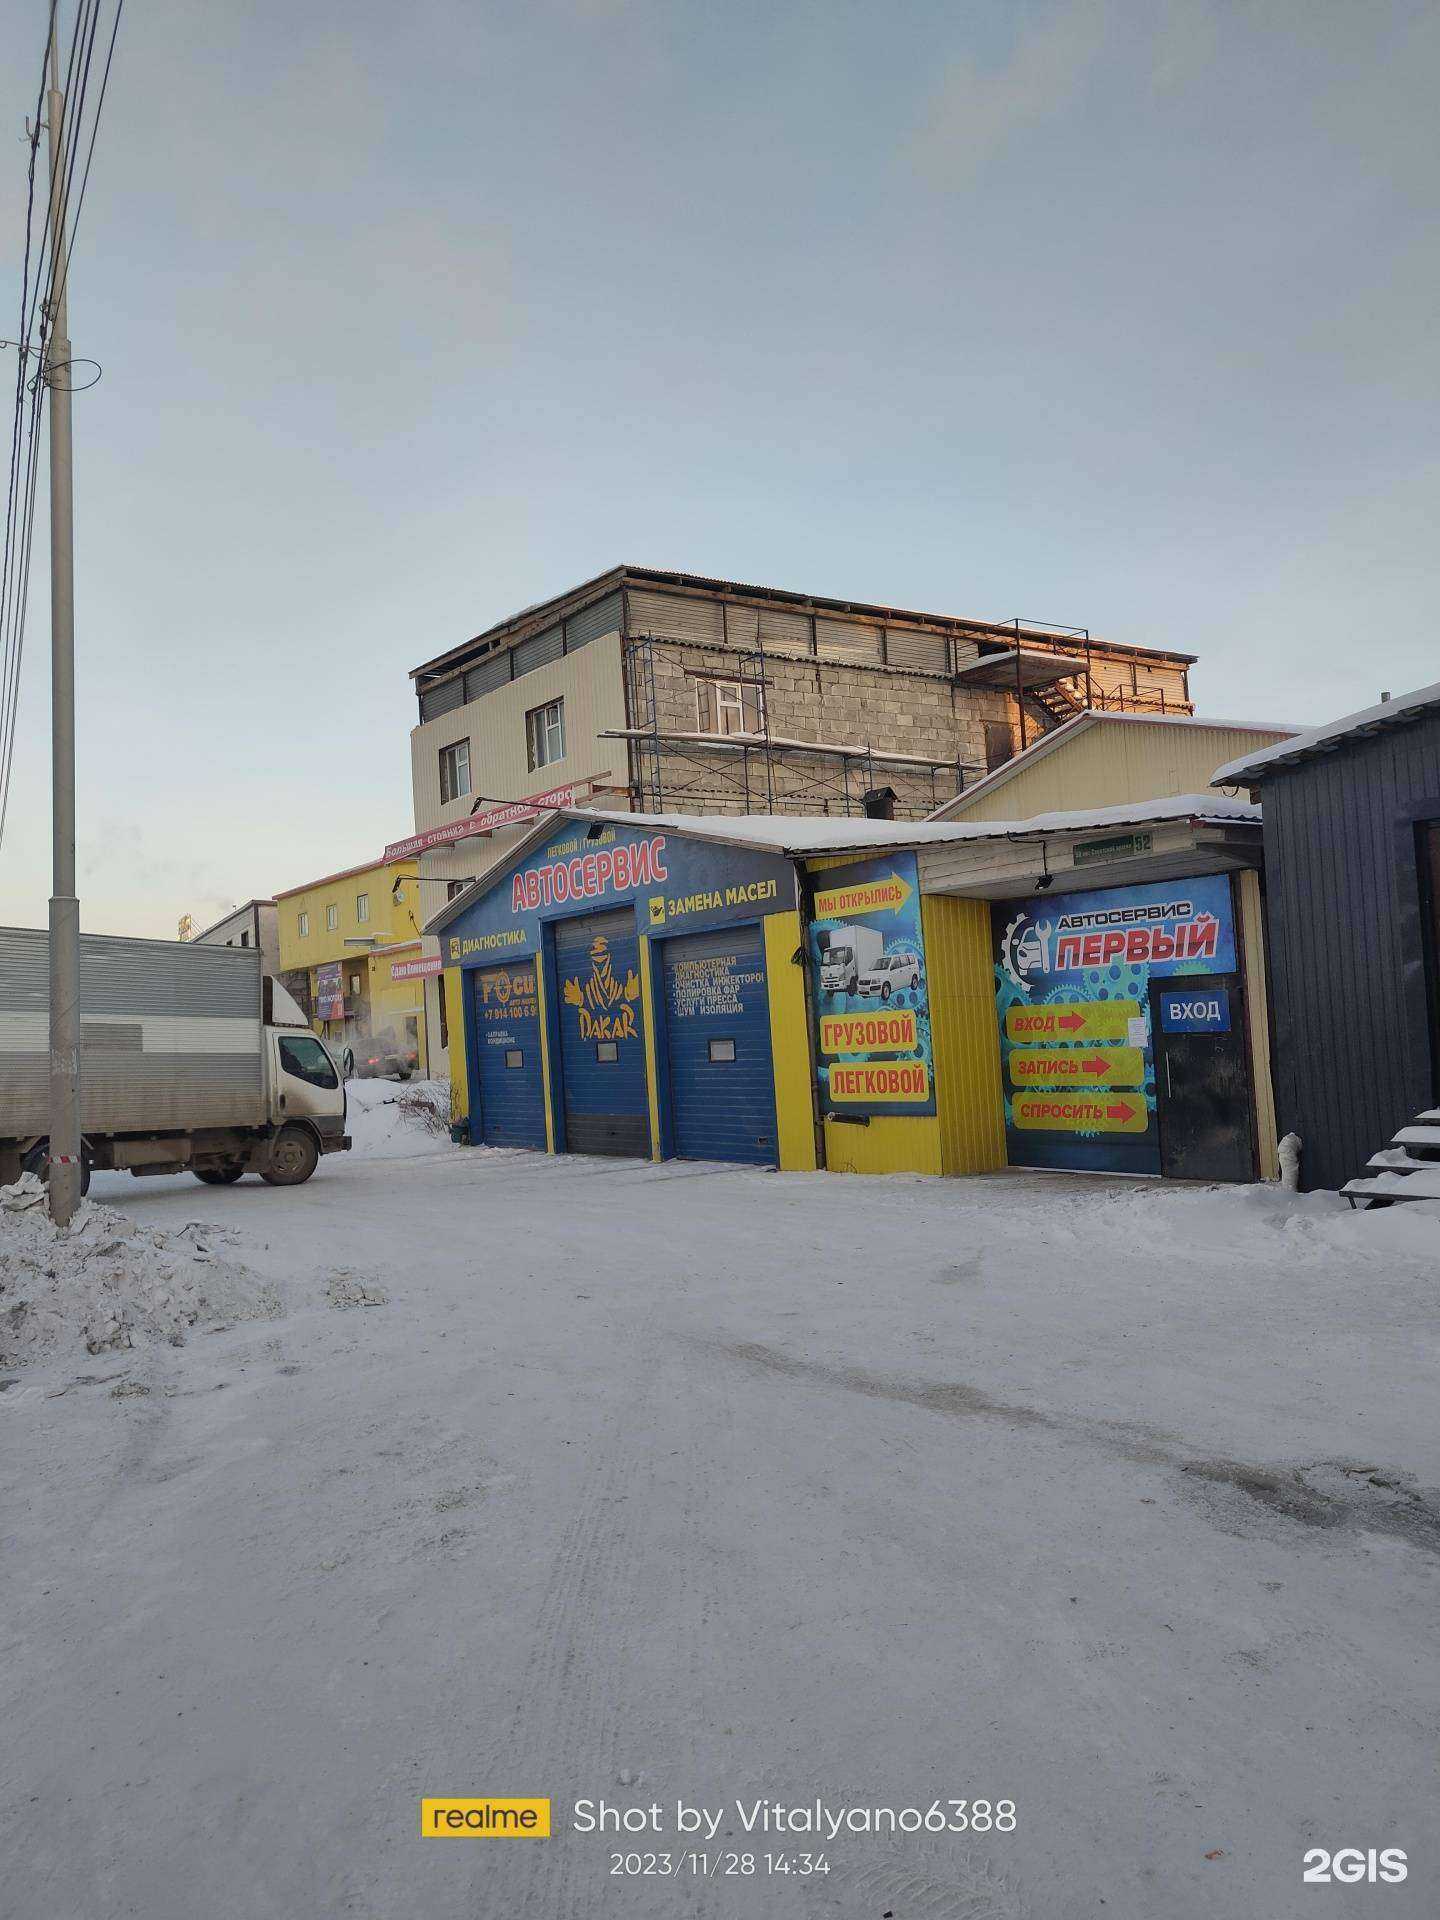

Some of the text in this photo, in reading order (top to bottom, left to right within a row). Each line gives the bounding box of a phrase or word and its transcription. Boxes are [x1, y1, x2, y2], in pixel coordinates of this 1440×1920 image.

[512, 836, 668, 913] АВТОСЕРВИС
[668, 879, 777, 917] ЗАМЕНА МАСЕЛ
[818, 885, 903, 912] МЫ ОТКРЫЛИСЬ
[1058, 902, 1192, 930] АВТОСЕРВИС
[462, 928, 527, 954] ДИАГНОСТИКА
[1056, 913, 1219, 970] ПЕРВЫЙ
[675, 956, 737, 971] КОМПЬЮТЕРНАЯ
[675, 966, 730, 981] ДИАГНОСТИКА
[675, 972, 764, 990] ОЧИСТКА ИНЖЕКТОРО
[676, 985, 740, 999] ПОЛИРОВКА ФАР
[707, 994, 738, 1005] ПРЕССА
[700, 1003, 744, 1015] ИЗОЛЯЦИЯ
[1169, 1000, 1221, 1021] ВХОД
[579, 1003, 638, 1040] DAKAR
[823, 1013, 914, 1048] ГРУЗОВОЙ
[1014, 1016, 1056, 1032] ВХОД
[1018, 1059, 1079, 1075] ЗАПИСЬ
[832, 1064, 926, 1096] ЛЕГКОВОЙ
[1020, 1103, 1104, 1120] СПРОСИТЬ
